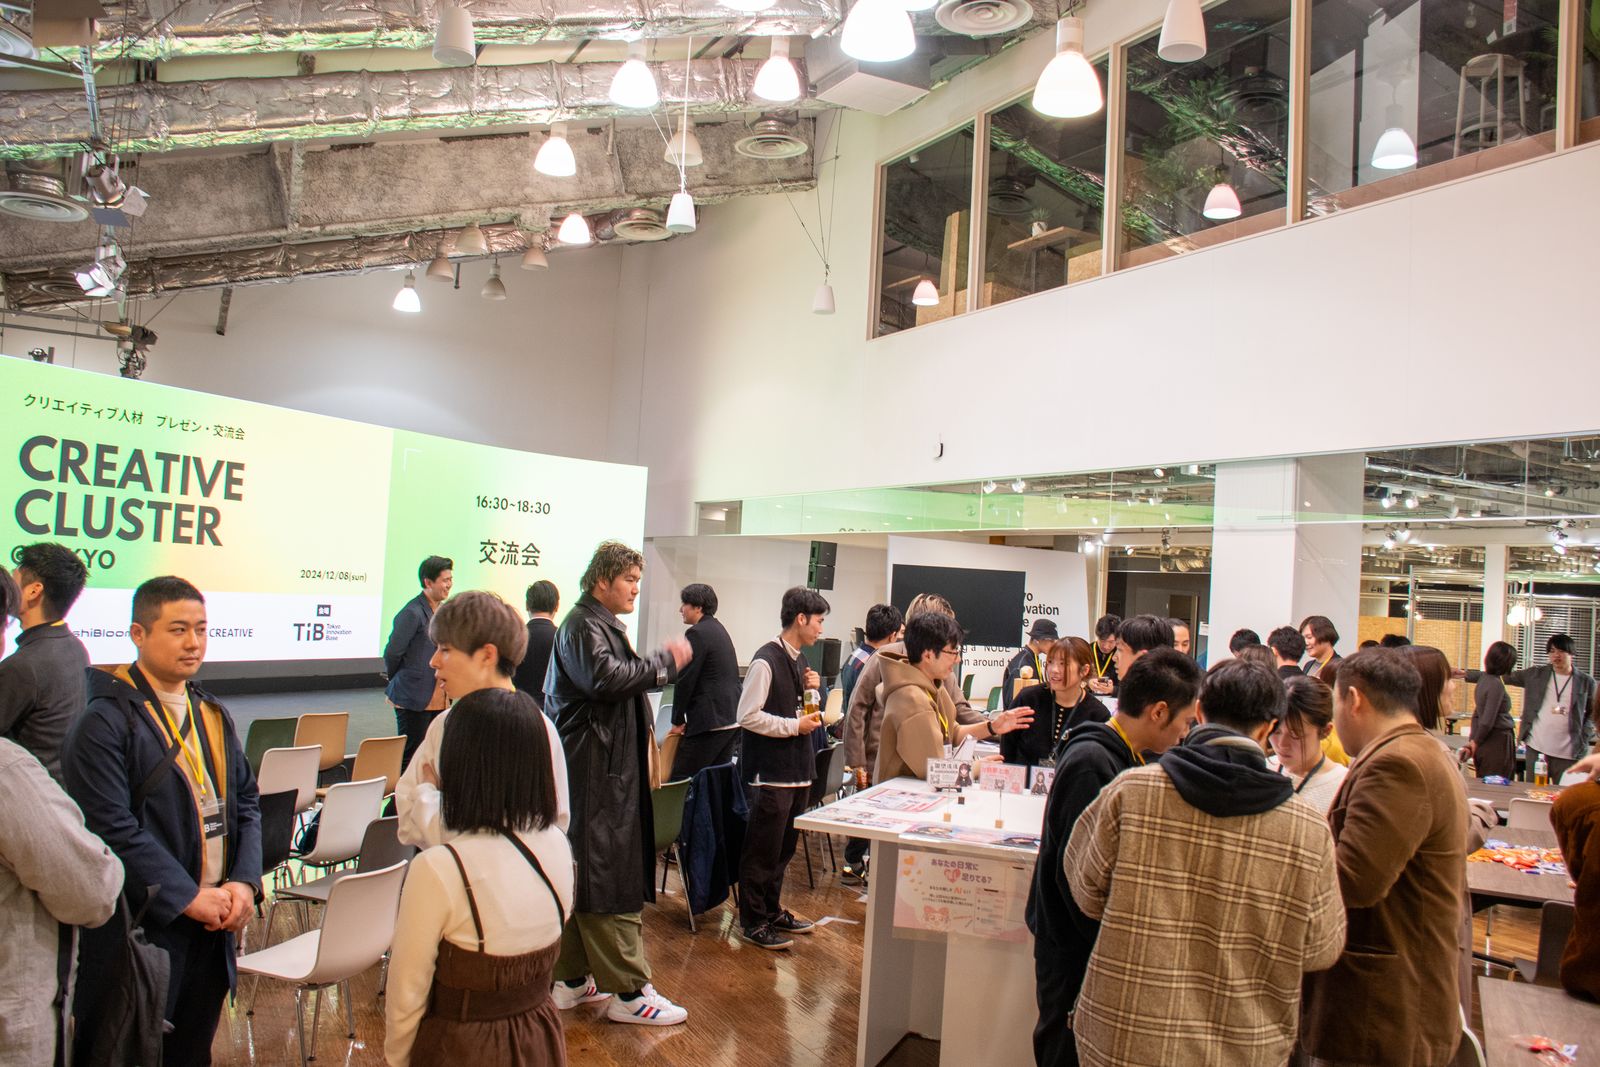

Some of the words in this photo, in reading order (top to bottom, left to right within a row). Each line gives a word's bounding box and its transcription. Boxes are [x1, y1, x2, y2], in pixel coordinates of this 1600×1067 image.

[24, 393, 144, 425] クリエイティブ人材
[156, 415, 246, 441] プレゼン・交流会
[19, 435, 246, 502] CREATIVE
[476, 495, 551, 515] 16:30~18:30
[15, 488, 223, 547] CLUSTER
[11, 545, 116, 569] @YO
[479, 539, 541, 567] 交流会
[300, 569, 367, 582] 2024/12/08(sun)
[1024, 603, 1059, 616] vation
[209, 628, 254, 638] CREATIVE
[293, 622, 325, 641] TiB
[973, 658, 1005, 667] around
